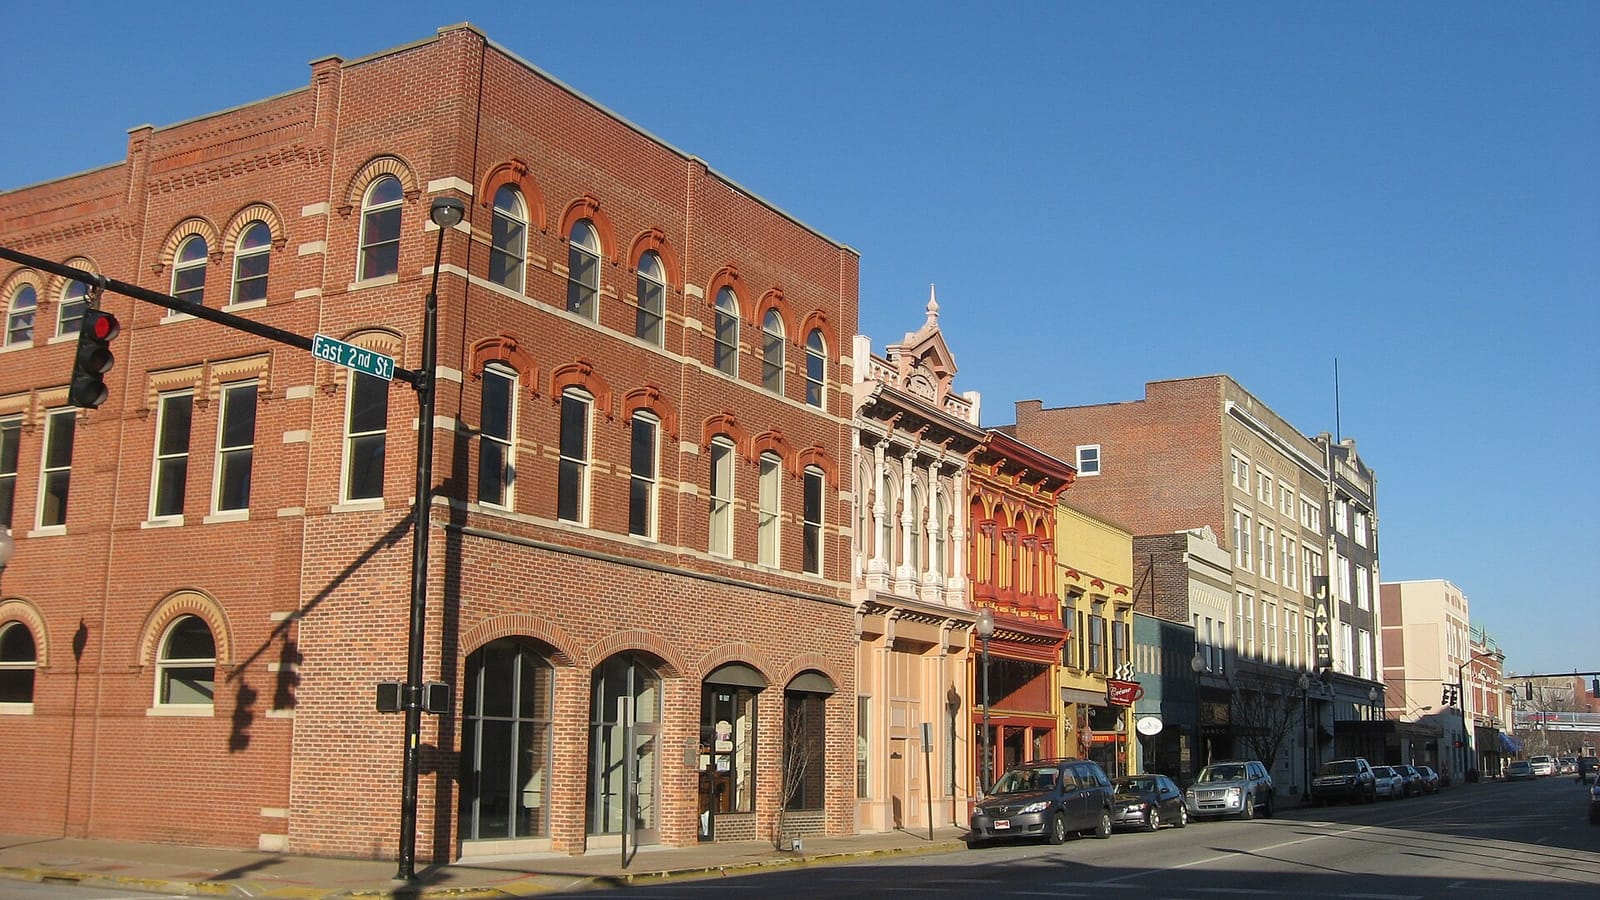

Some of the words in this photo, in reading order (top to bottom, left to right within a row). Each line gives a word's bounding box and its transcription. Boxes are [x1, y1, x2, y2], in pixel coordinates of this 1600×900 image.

[314, 337, 343, 363] East
[347, 348, 371, 368] 2nd
[375, 357, 390, 378] St.
[1316, 585, 1328, 636] JAX
